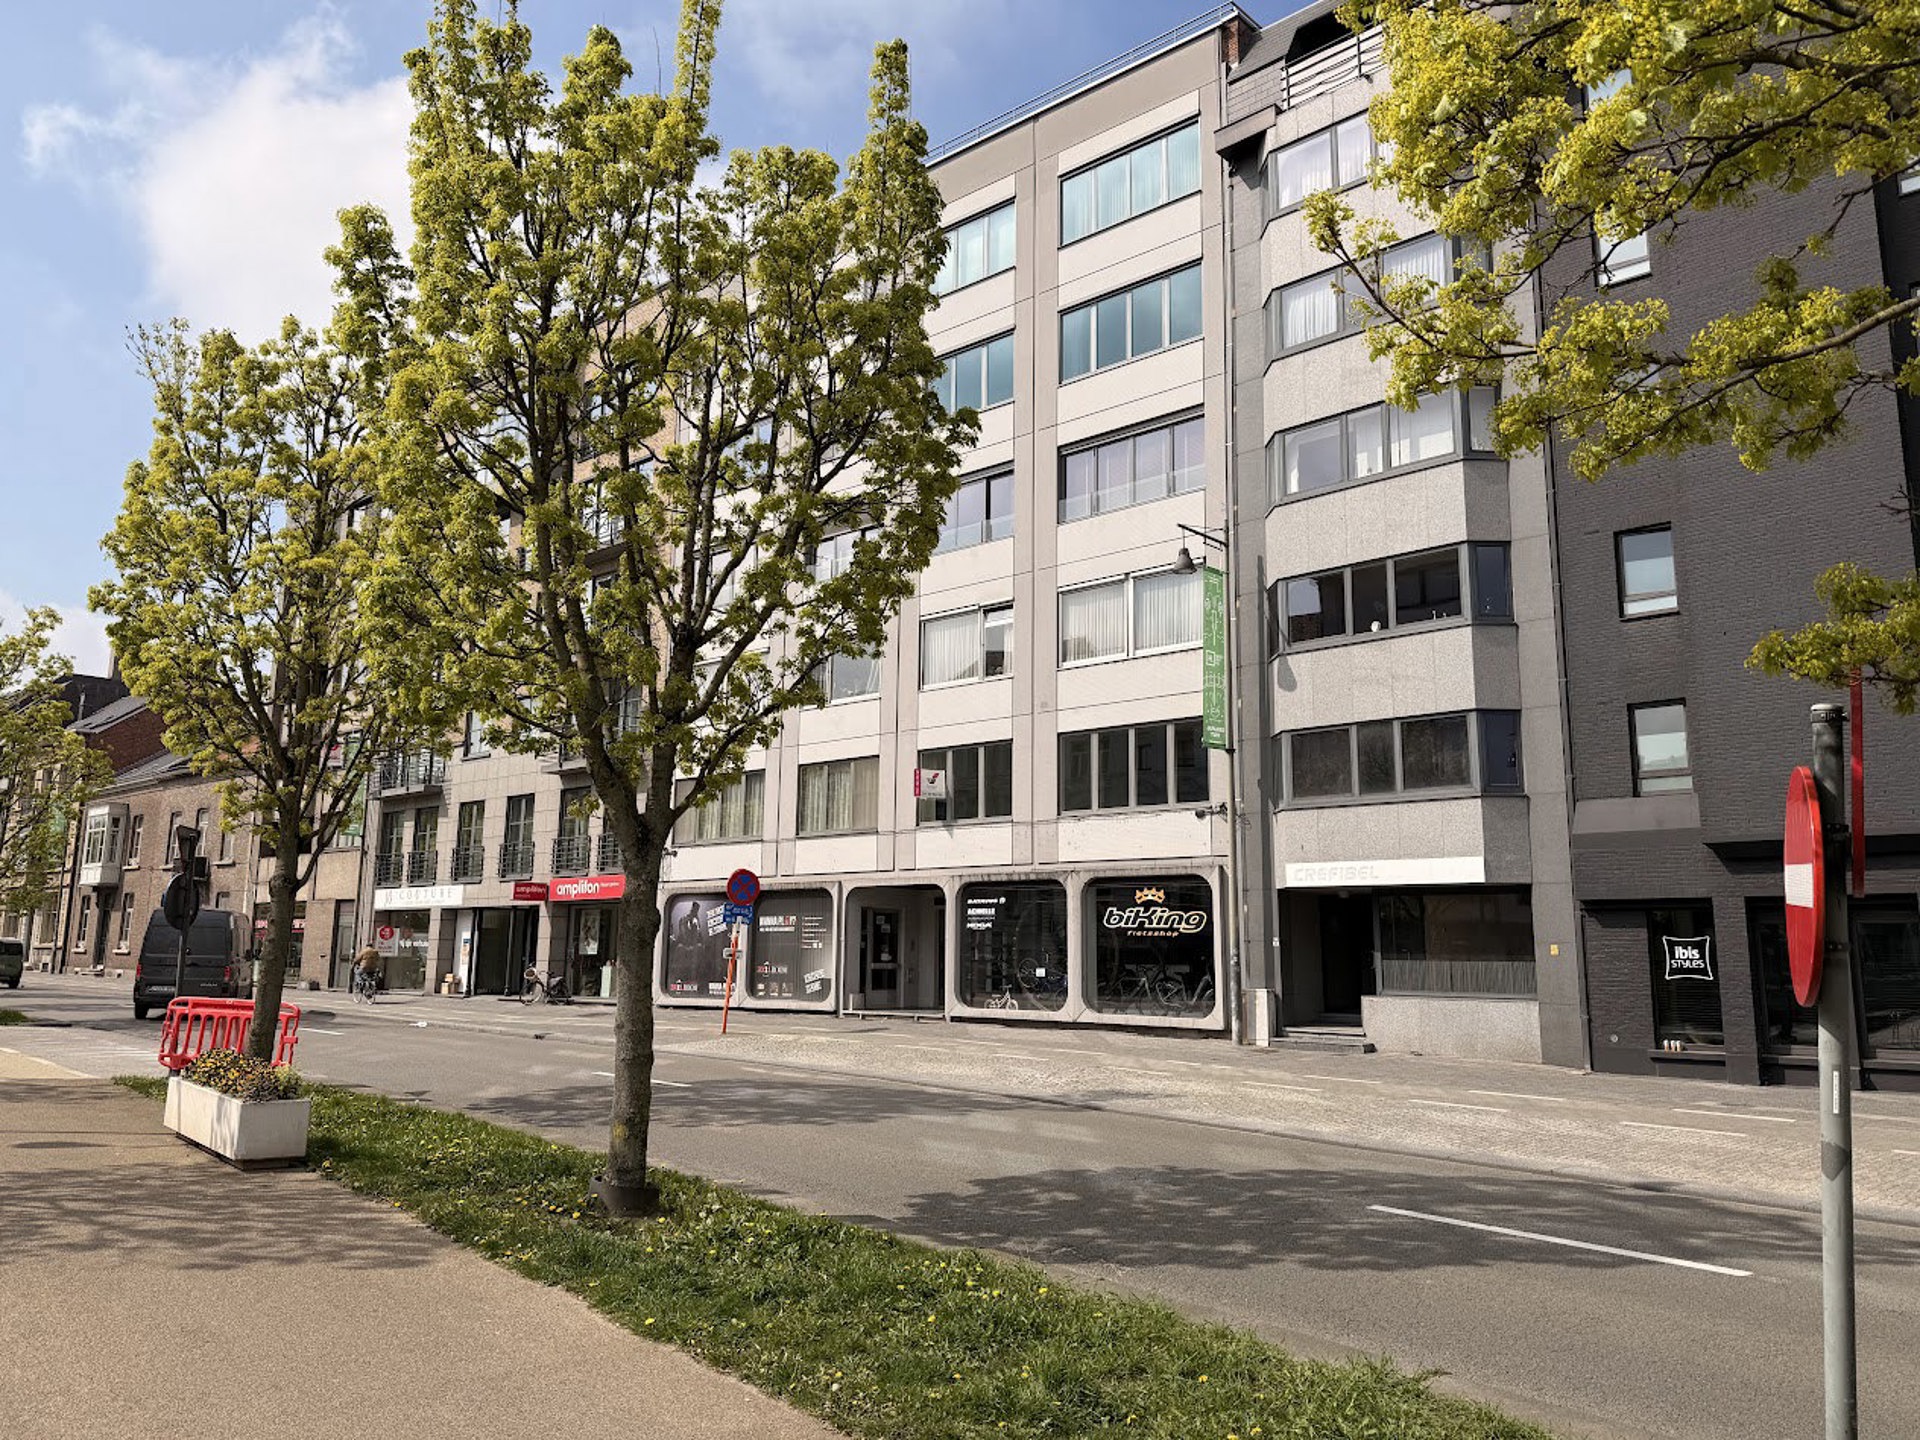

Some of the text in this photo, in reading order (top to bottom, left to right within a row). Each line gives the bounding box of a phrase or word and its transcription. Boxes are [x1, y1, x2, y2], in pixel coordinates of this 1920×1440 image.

[1294, 865, 1379, 882] CREFIBEL
[556, 879, 600, 898] amplifon
[1103, 906, 1207, 933] biKing
[1674, 946, 1700, 959] ibis
